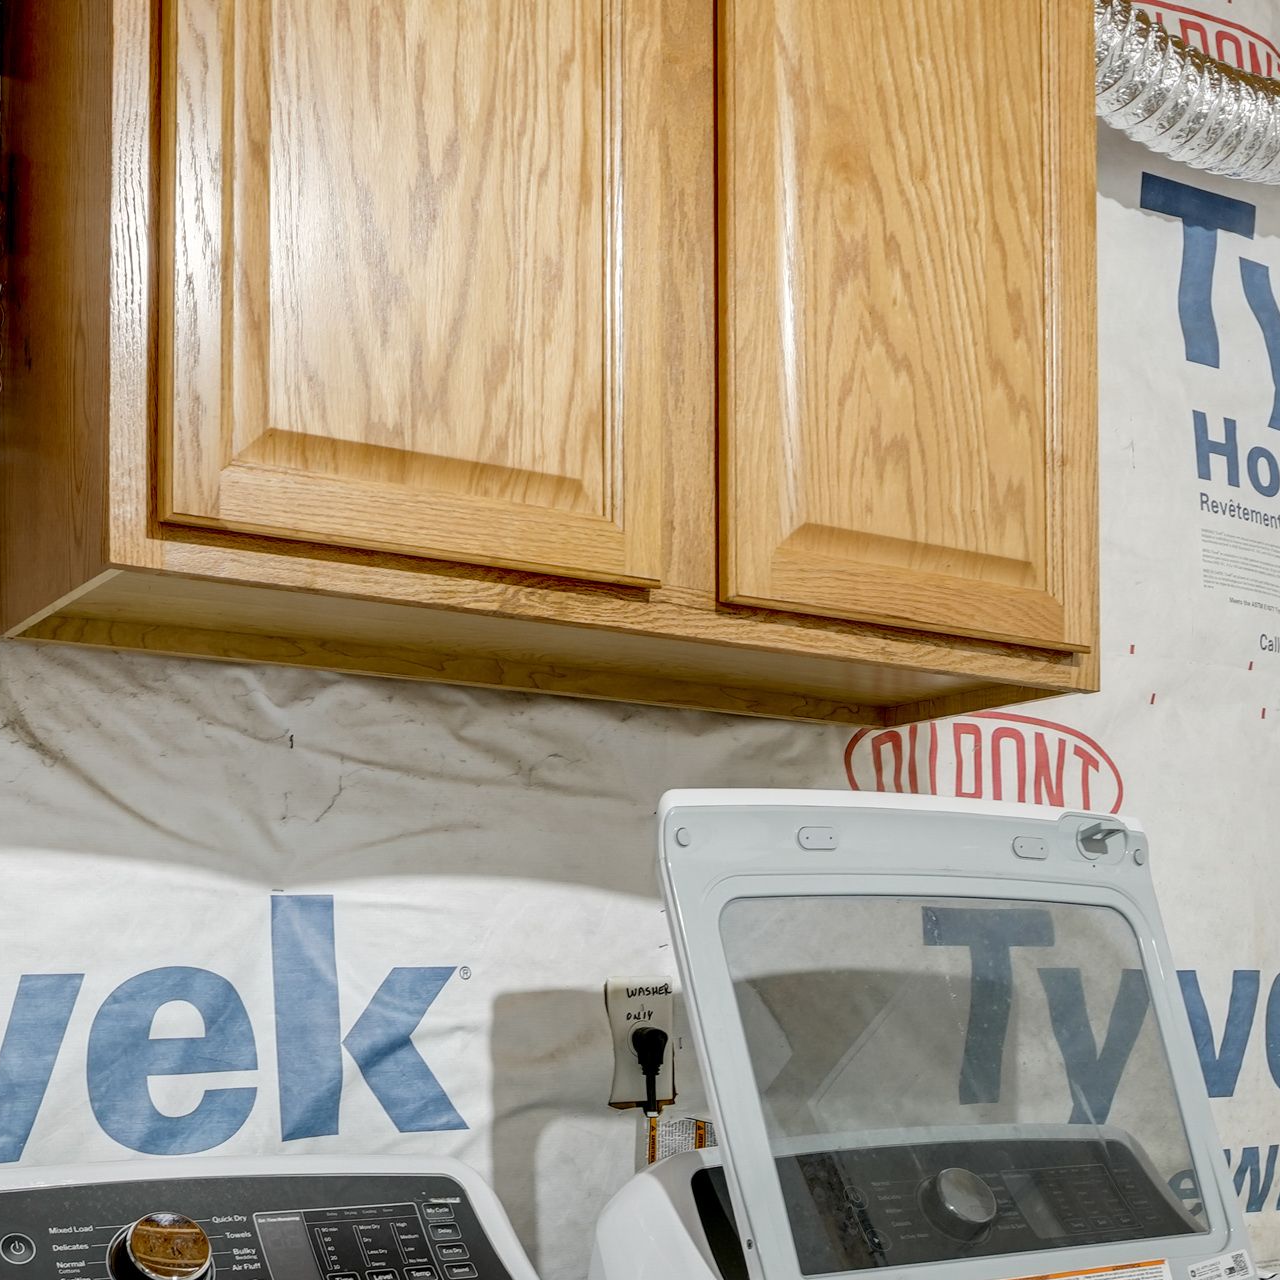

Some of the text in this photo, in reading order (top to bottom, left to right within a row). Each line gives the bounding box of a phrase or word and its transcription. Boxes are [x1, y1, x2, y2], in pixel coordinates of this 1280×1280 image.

[1260, 633, 1280, 653] Call
[626, 983, 673, 998] WASHER
[212, 1216, 232, 1224] Quick
[234, 1214, 248, 1223] Dry
[48, 1225, 94, 1234] Mixed Load
[225, 1231, 252, 1239] Towels
[52, 1243, 89, 1251] Delicates
[232, 1248, 256, 1256] Bulky
[56, 1260, 86, 1268] Normal
[244, 1262, 262, 1270] Fluff
[410, 1270, 432, 1278] Temp
